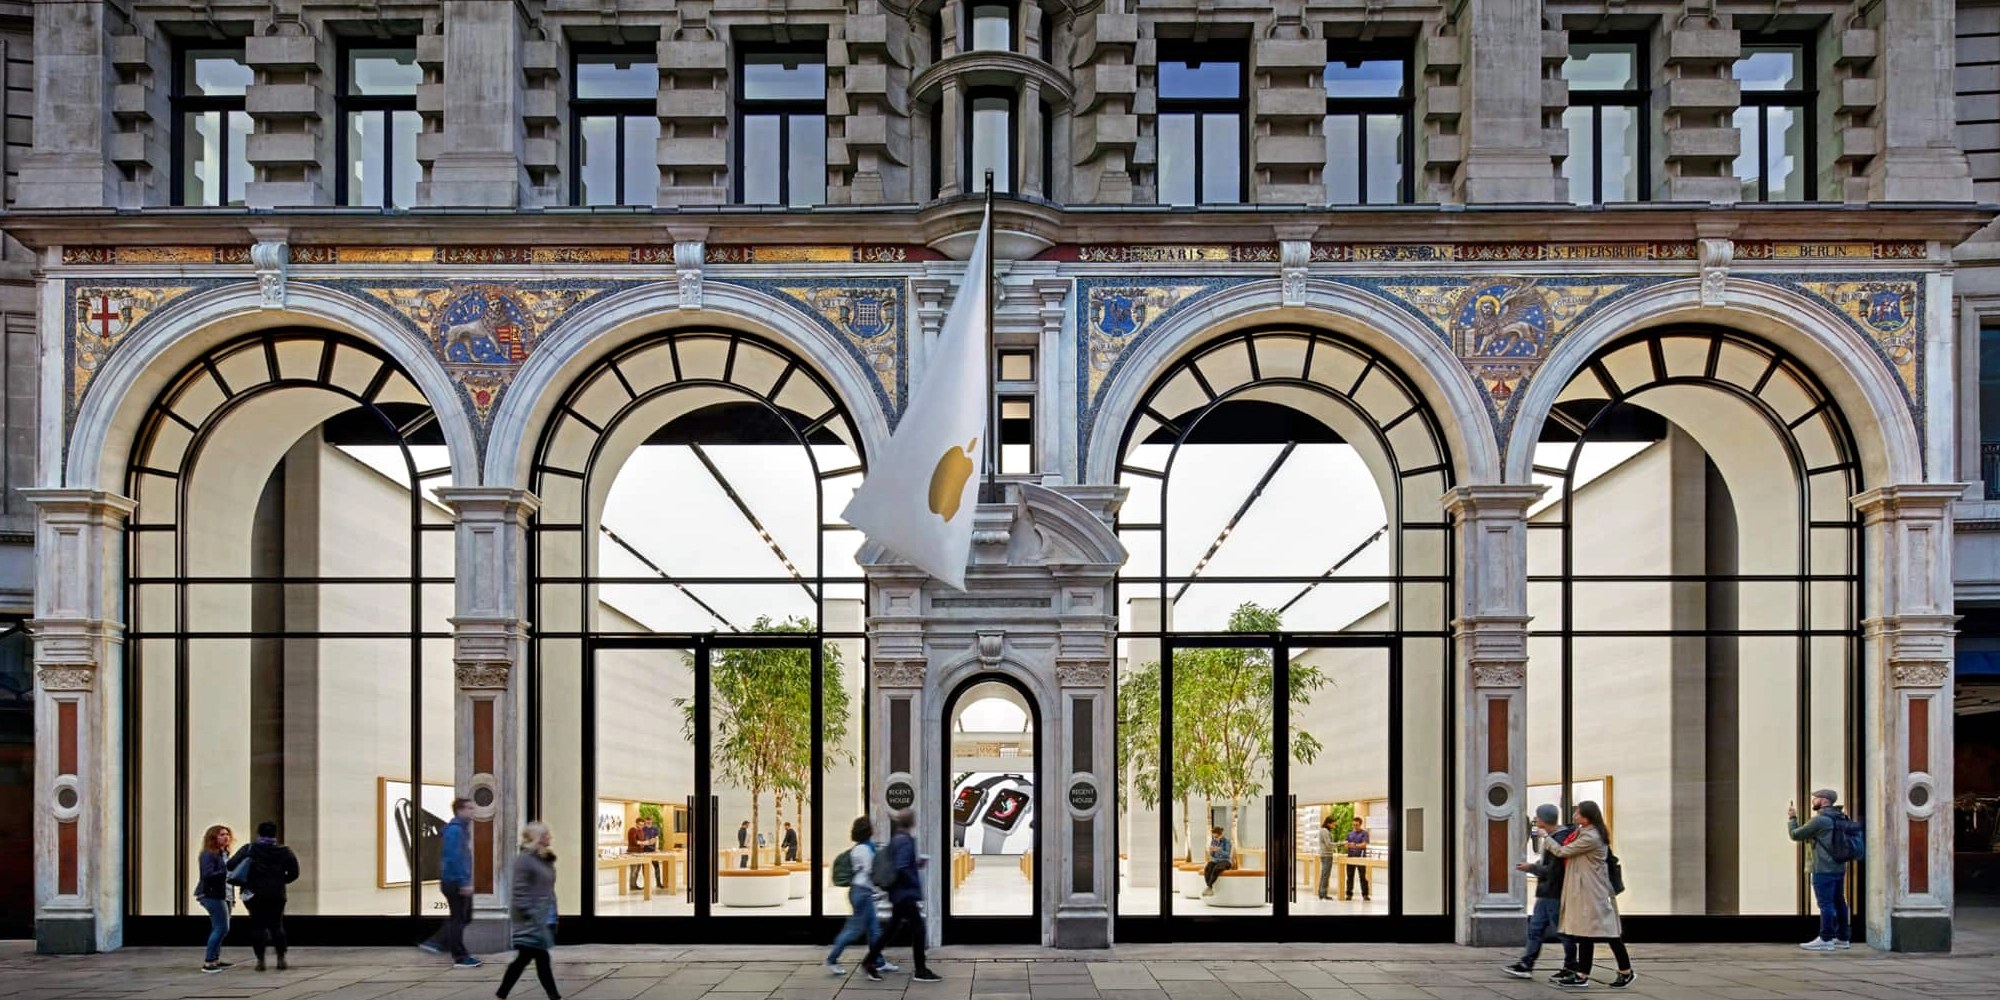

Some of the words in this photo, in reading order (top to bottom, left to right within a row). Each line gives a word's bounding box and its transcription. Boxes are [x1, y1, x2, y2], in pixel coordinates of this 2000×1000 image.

[1156, 248, 1204, 259] PARIS
[1567, 246, 1643, 257] PETERSBURG
[1800, 246, 1846, 256] BERLIN
